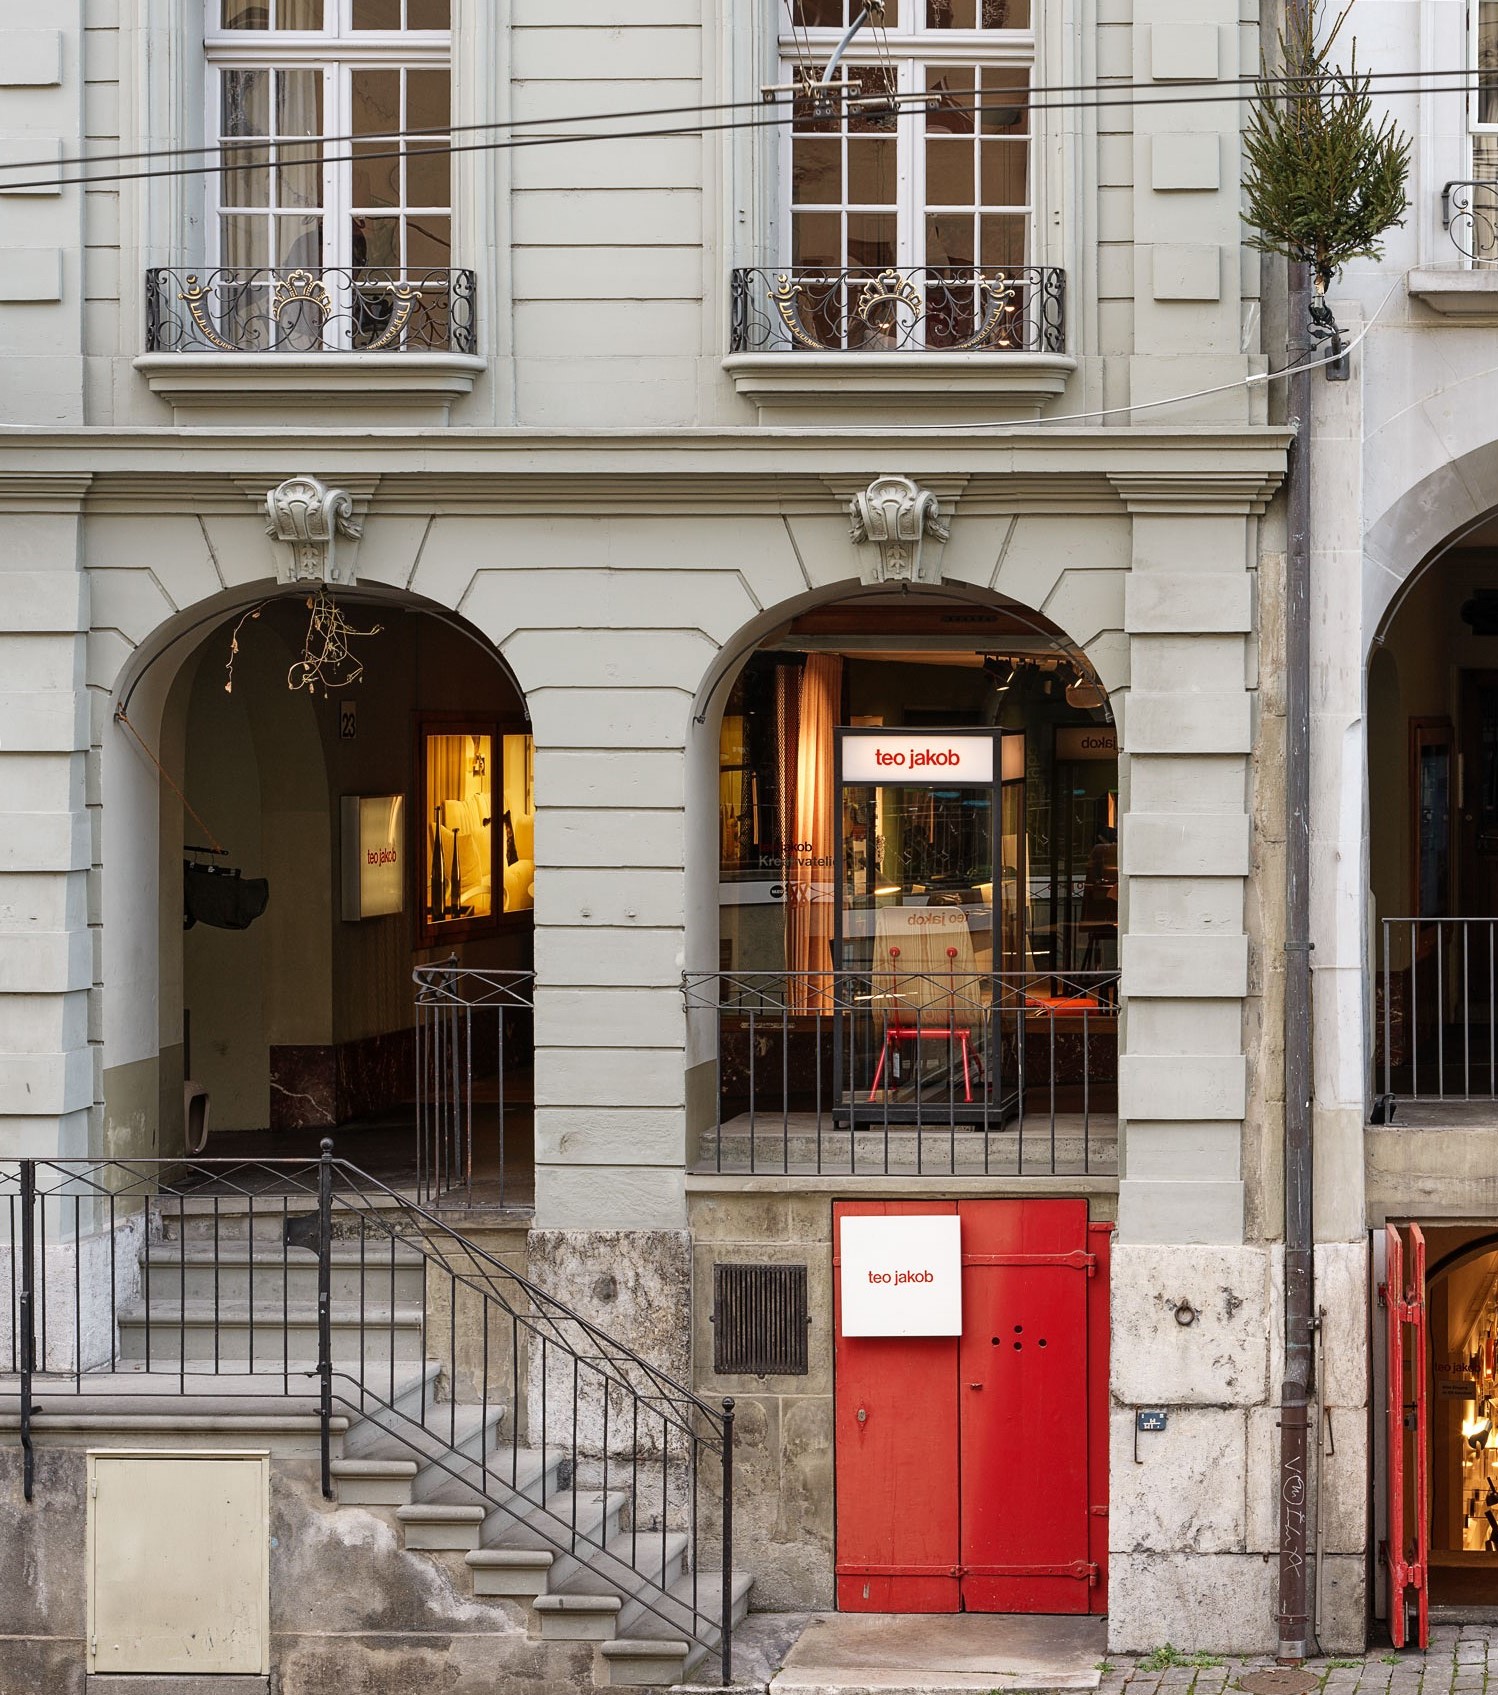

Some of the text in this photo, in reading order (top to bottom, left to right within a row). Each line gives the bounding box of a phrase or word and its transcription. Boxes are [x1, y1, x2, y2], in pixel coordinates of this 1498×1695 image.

[342, 713, 356, 738] 23
[875, 749, 960, 769] teo jakob
[367, 848, 397, 867] teo jakob
[868, 1270, 934, 1286] teo jakob
